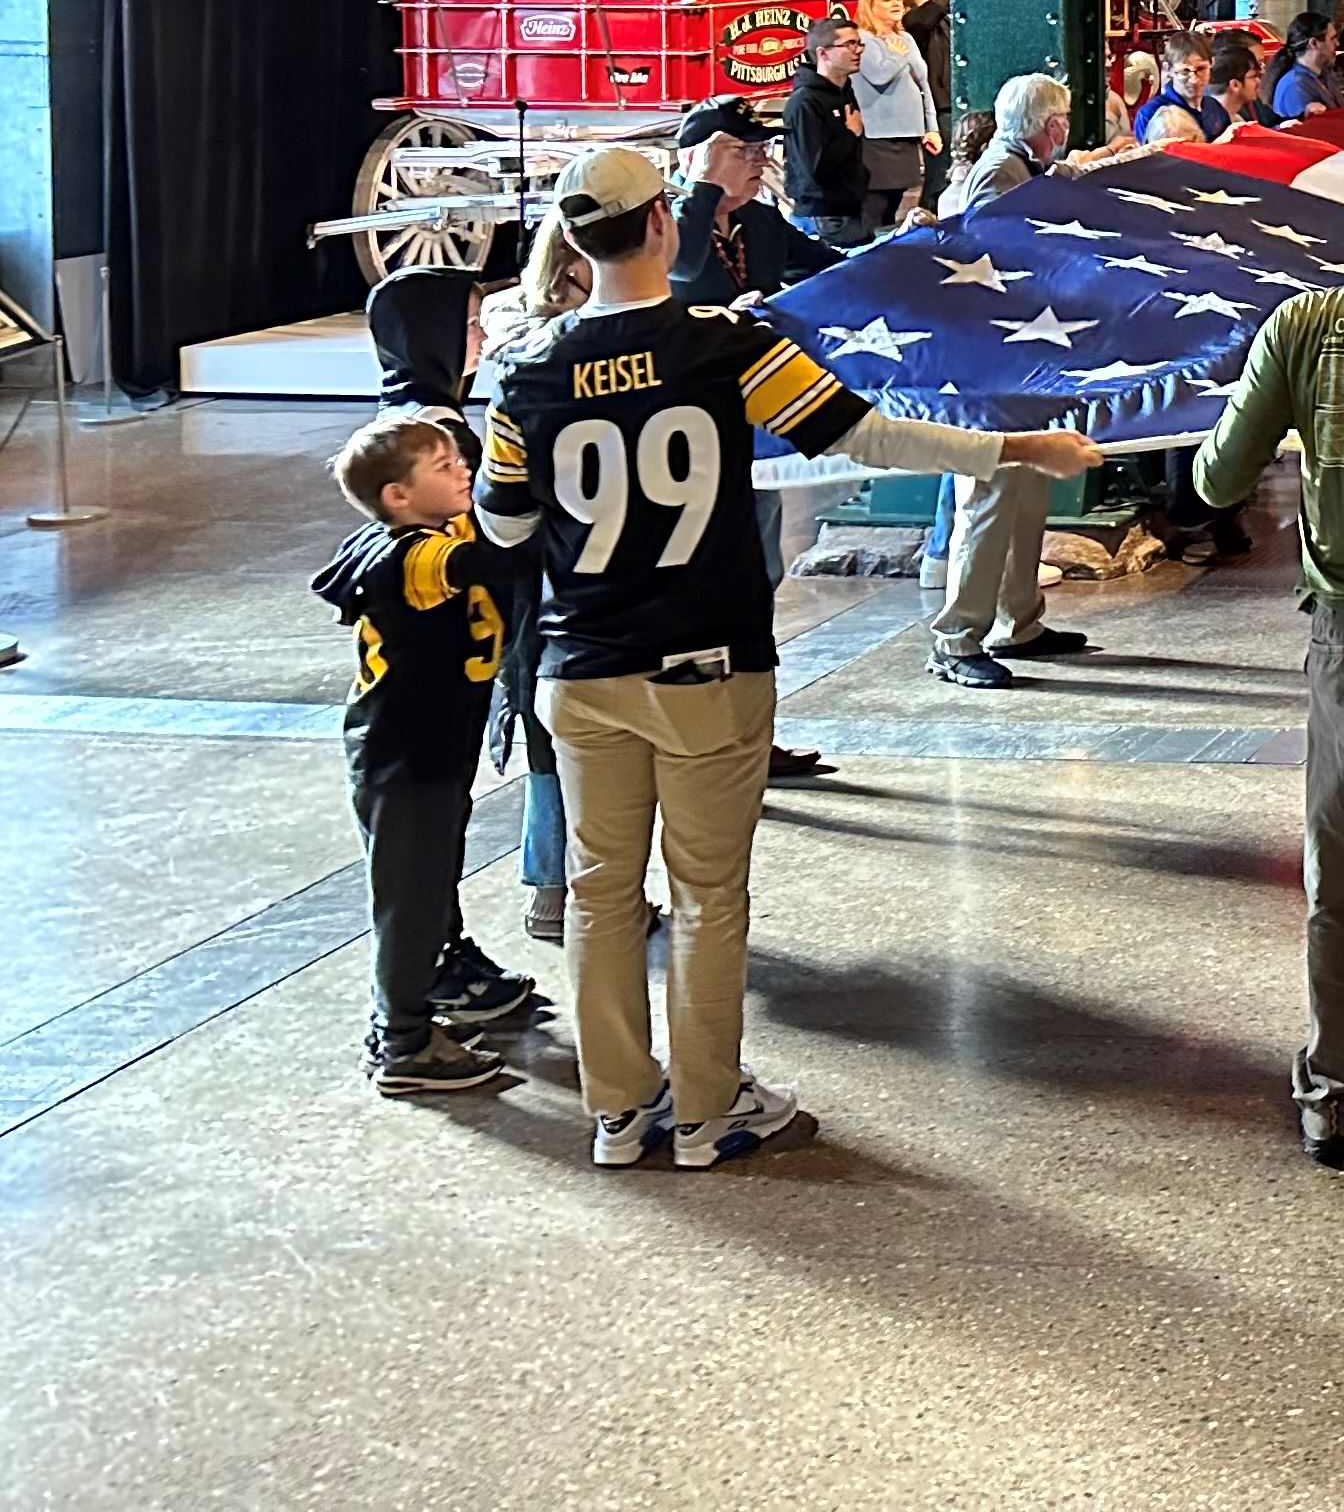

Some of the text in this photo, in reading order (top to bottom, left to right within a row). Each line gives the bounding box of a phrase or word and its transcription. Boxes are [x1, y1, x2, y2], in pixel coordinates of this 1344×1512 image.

[523, 20, 571, 36] Heinz
[754, 8, 791, 28] HEINZ
[730, 60, 787, 83] PITTSBURGH
[573, 351, 664, 400] KEISEL
[552, 405, 721, 574] 99
